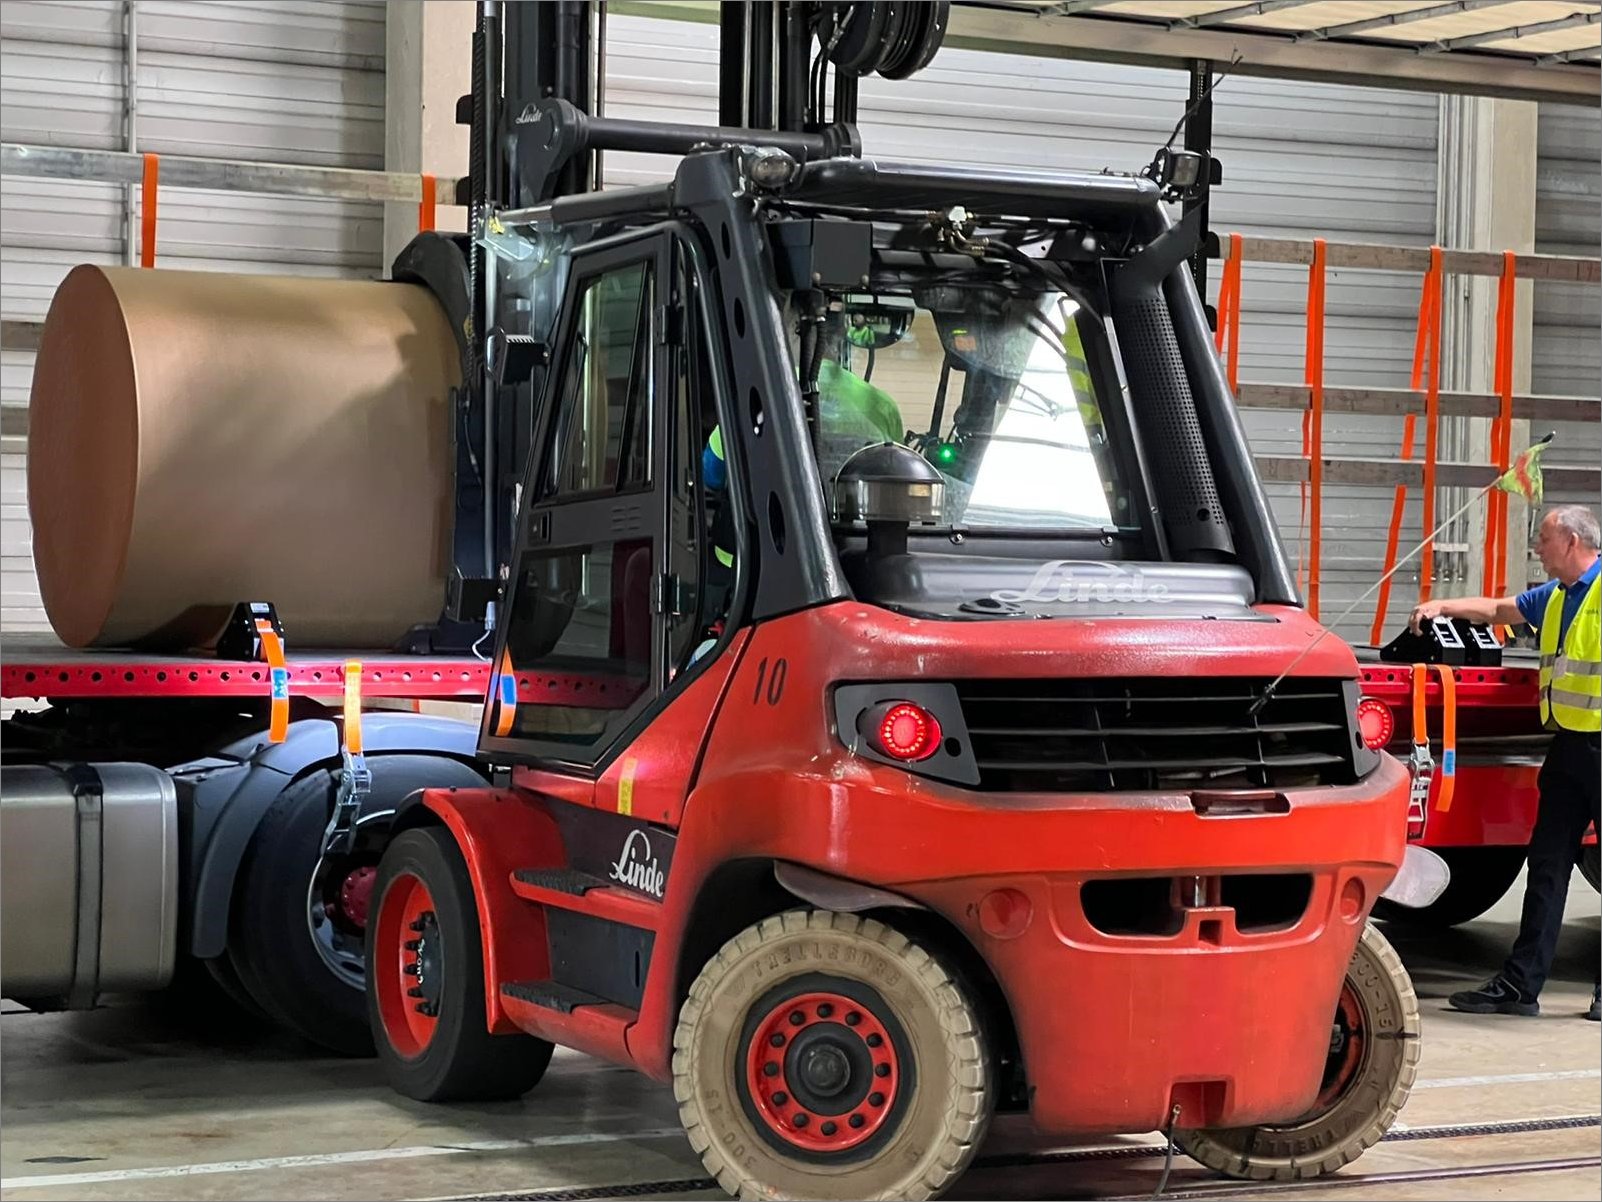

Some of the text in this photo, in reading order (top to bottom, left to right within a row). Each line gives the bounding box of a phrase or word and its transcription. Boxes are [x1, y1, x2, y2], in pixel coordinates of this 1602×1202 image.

[514, 102, 543, 125] Linde
[989, 559, 1174, 603] Linde
[752, 656, 788, 706] 10
[608, 829, 665, 898] Linde
